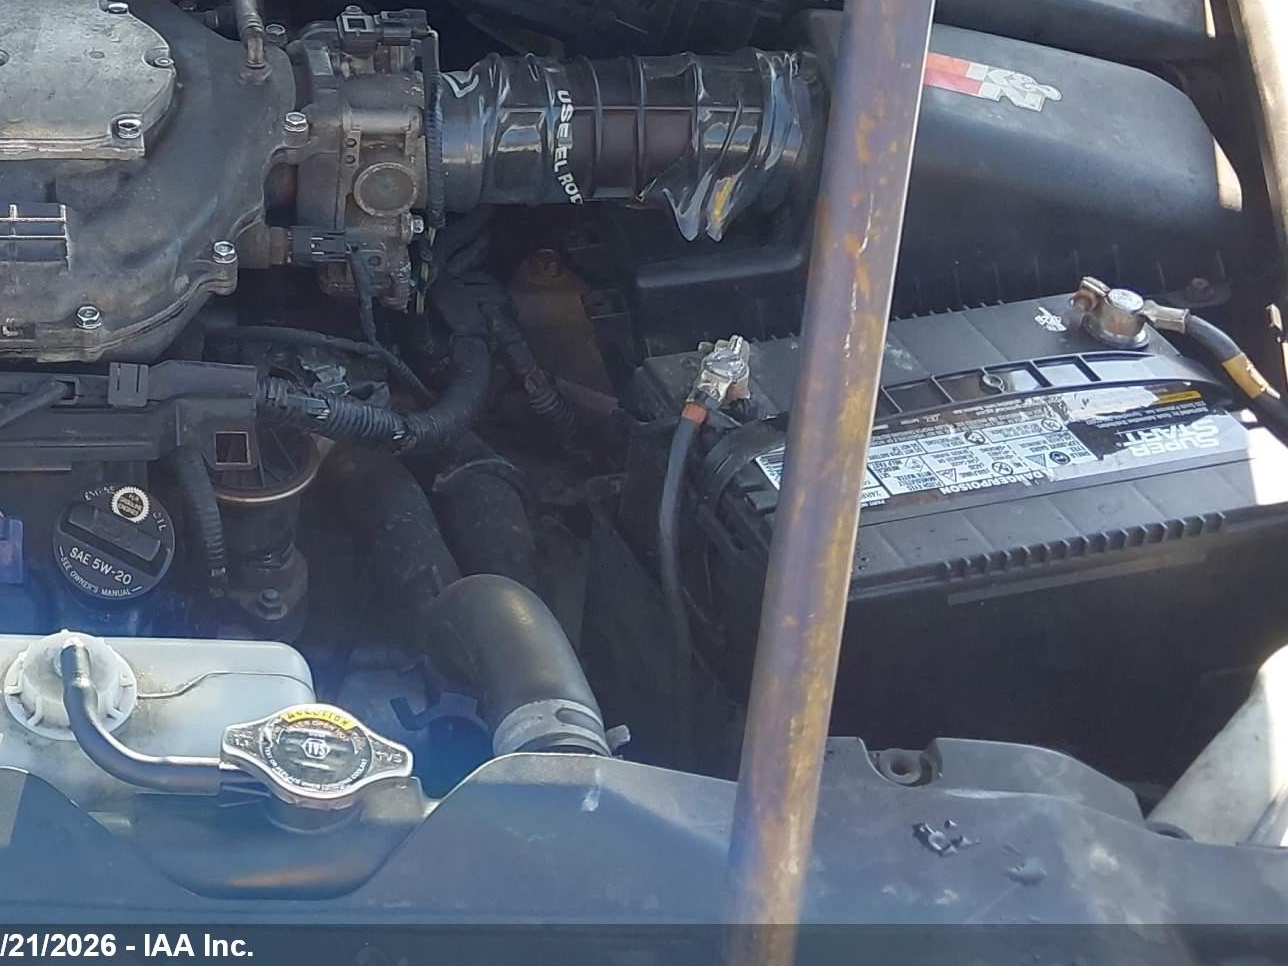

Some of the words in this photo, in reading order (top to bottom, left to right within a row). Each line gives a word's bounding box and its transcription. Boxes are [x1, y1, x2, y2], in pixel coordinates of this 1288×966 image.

[557, 89, 574, 139] USE
[1122, 418, 1219, 447] START
[1127, 433, 1219, 458] SUPER
[60, 556, 73, 571] SEE
[70, 571, 99, 594] OWNER'S
[101, 588, 132, 597] MANUAL
[70, 547, 92, 566] SAE
[92, 558, 132, 585] 5W-20
[307, 740, 326, 756] TVS
[375, 750, 402, 763] TVS
